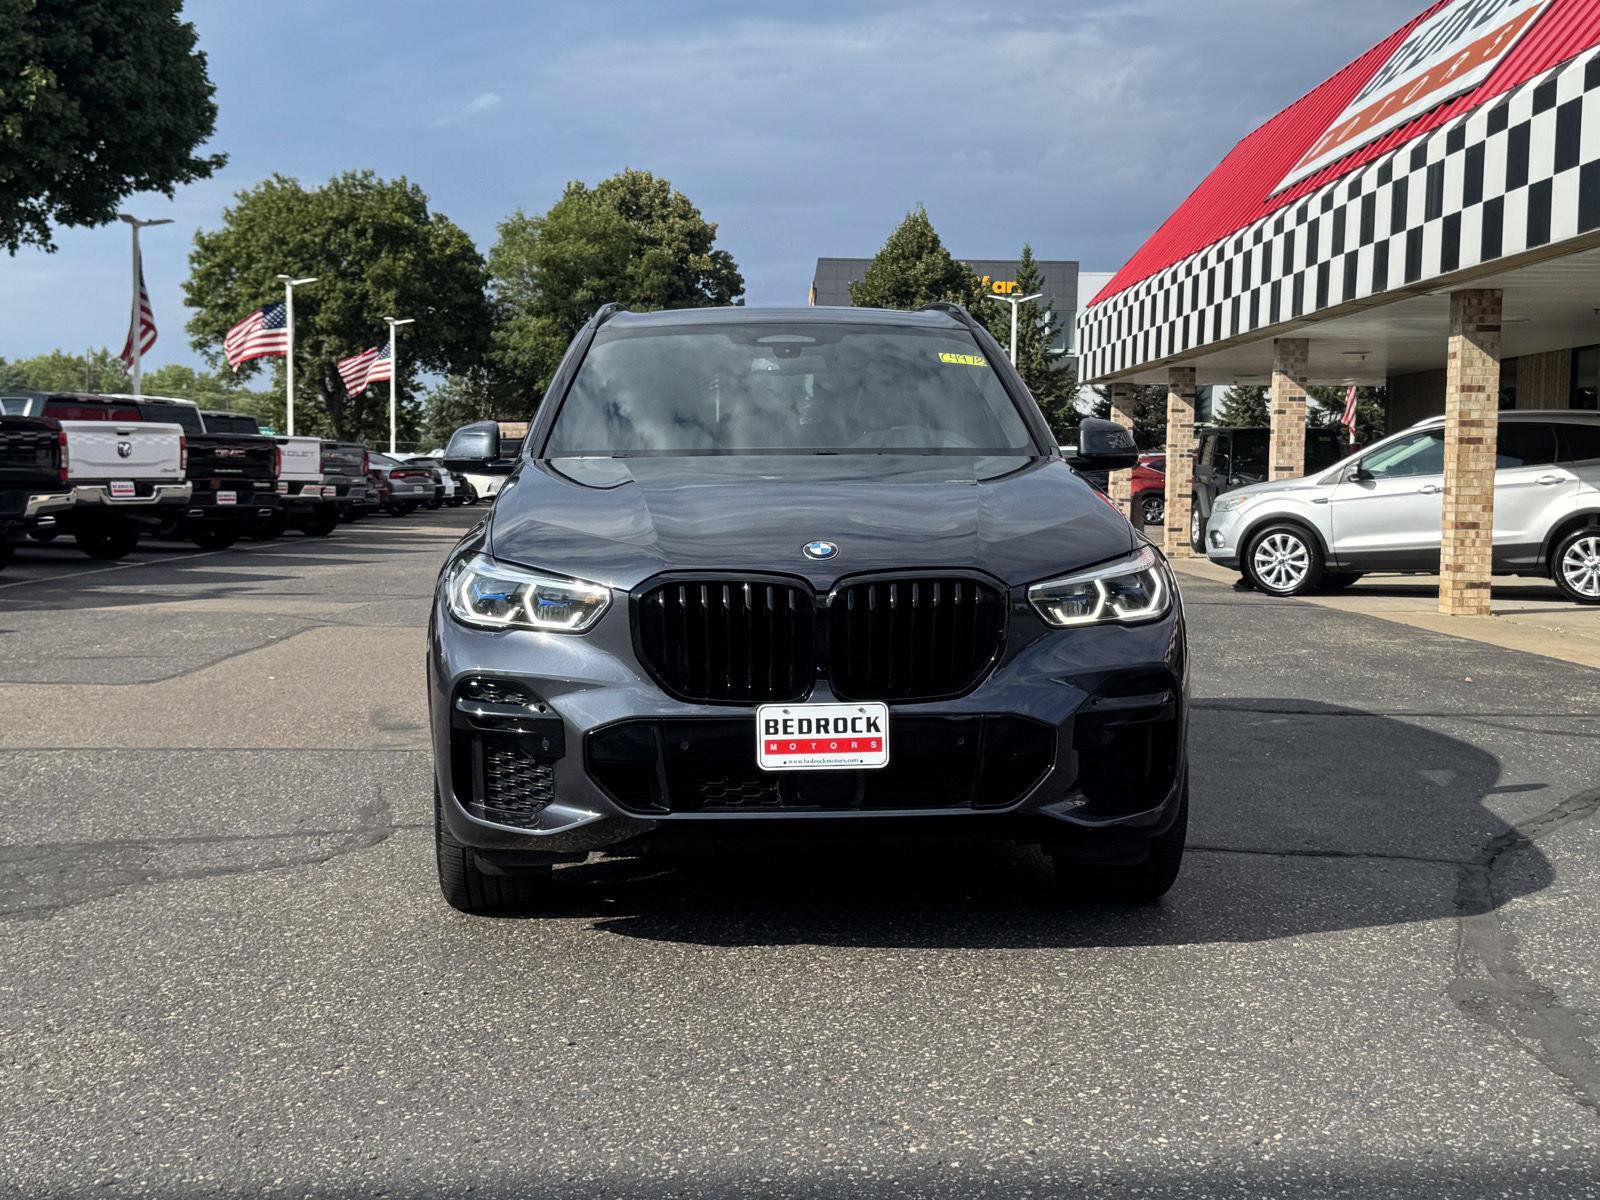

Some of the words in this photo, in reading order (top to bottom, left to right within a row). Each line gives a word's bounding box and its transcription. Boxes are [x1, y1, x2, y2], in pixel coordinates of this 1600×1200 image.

[764, 716, 881, 736] BEDROCK
[770, 741, 877, 751] MOTORS
[787, 757, 859, 765] www.bedrockmotors.com
